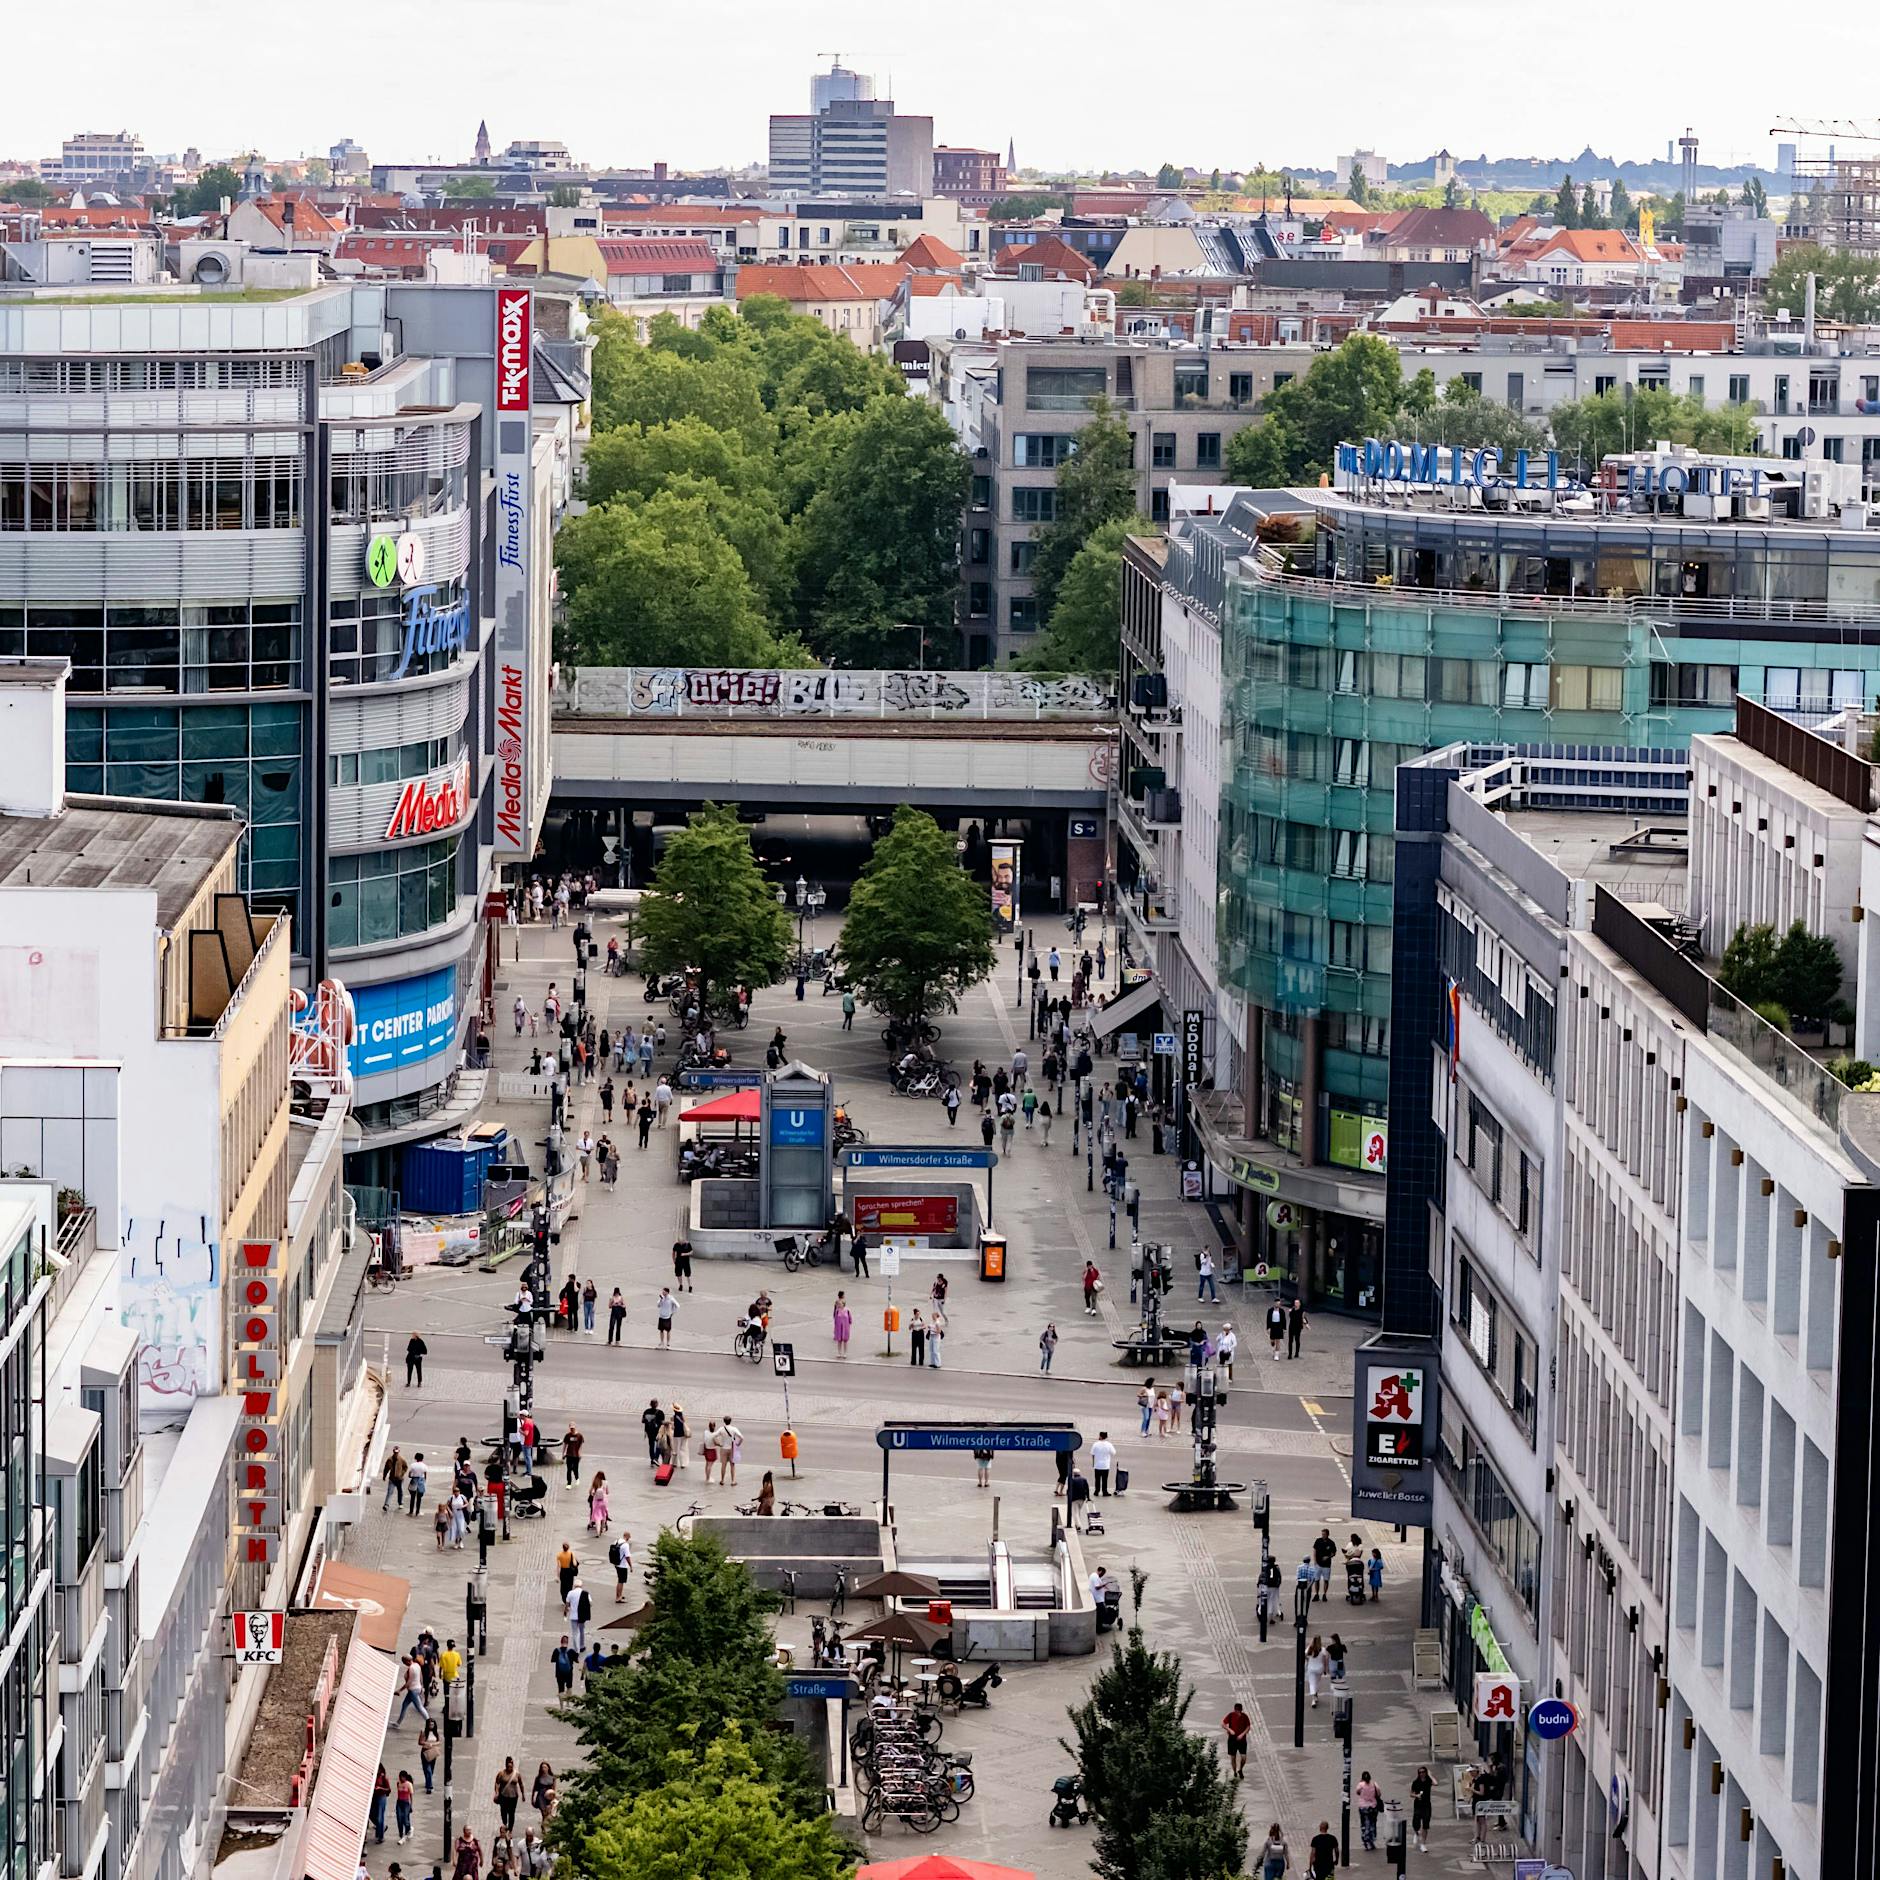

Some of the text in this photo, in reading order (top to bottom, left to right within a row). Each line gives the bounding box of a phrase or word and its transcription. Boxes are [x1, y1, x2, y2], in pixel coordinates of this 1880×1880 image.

[1074, 823, 1084, 835] S
[371, 1009, 423, 1042] CENTER
[690, 1076, 698, 1084] U
[790, 1111, 805, 1127] U
[851, 1153, 973, 1165] U Wilmersdorfer Straße
[242, 1243, 272, 1563] WOOLWORTH
[892, 1432, 1051, 1447] U Wilmersdorfer Straße
[1378, 1434, 1395, 1454] E
[1368, 1455, 1419, 1466] ZIGARETTEN
[243, 1650, 276, 1662] KFC
[793, 1683, 827, 1695] Straße
[1538, 1713, 1570, 1725] budni
